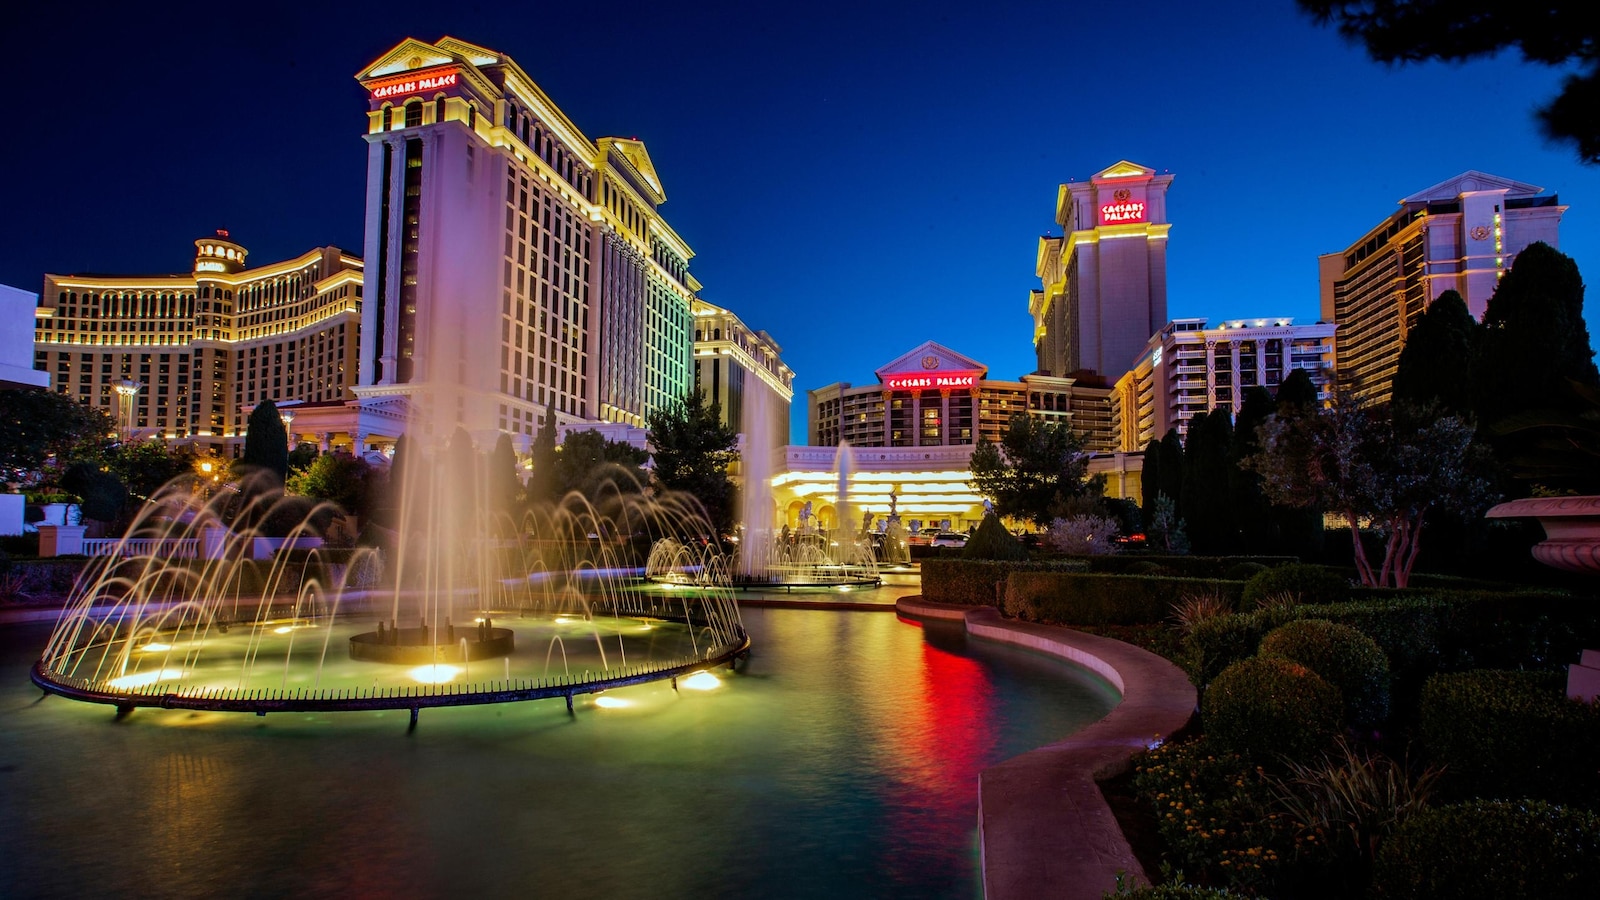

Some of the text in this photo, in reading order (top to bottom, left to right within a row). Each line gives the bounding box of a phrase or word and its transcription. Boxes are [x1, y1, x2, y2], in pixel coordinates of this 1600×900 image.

[373, 74, 456, 97] CAESARS PALACE
[1102, 203, 1144, 213] CAESARS
[1104, 211, 1142, 221] PALACE
[889, 377, 973, 388] CAESARS PALACE
